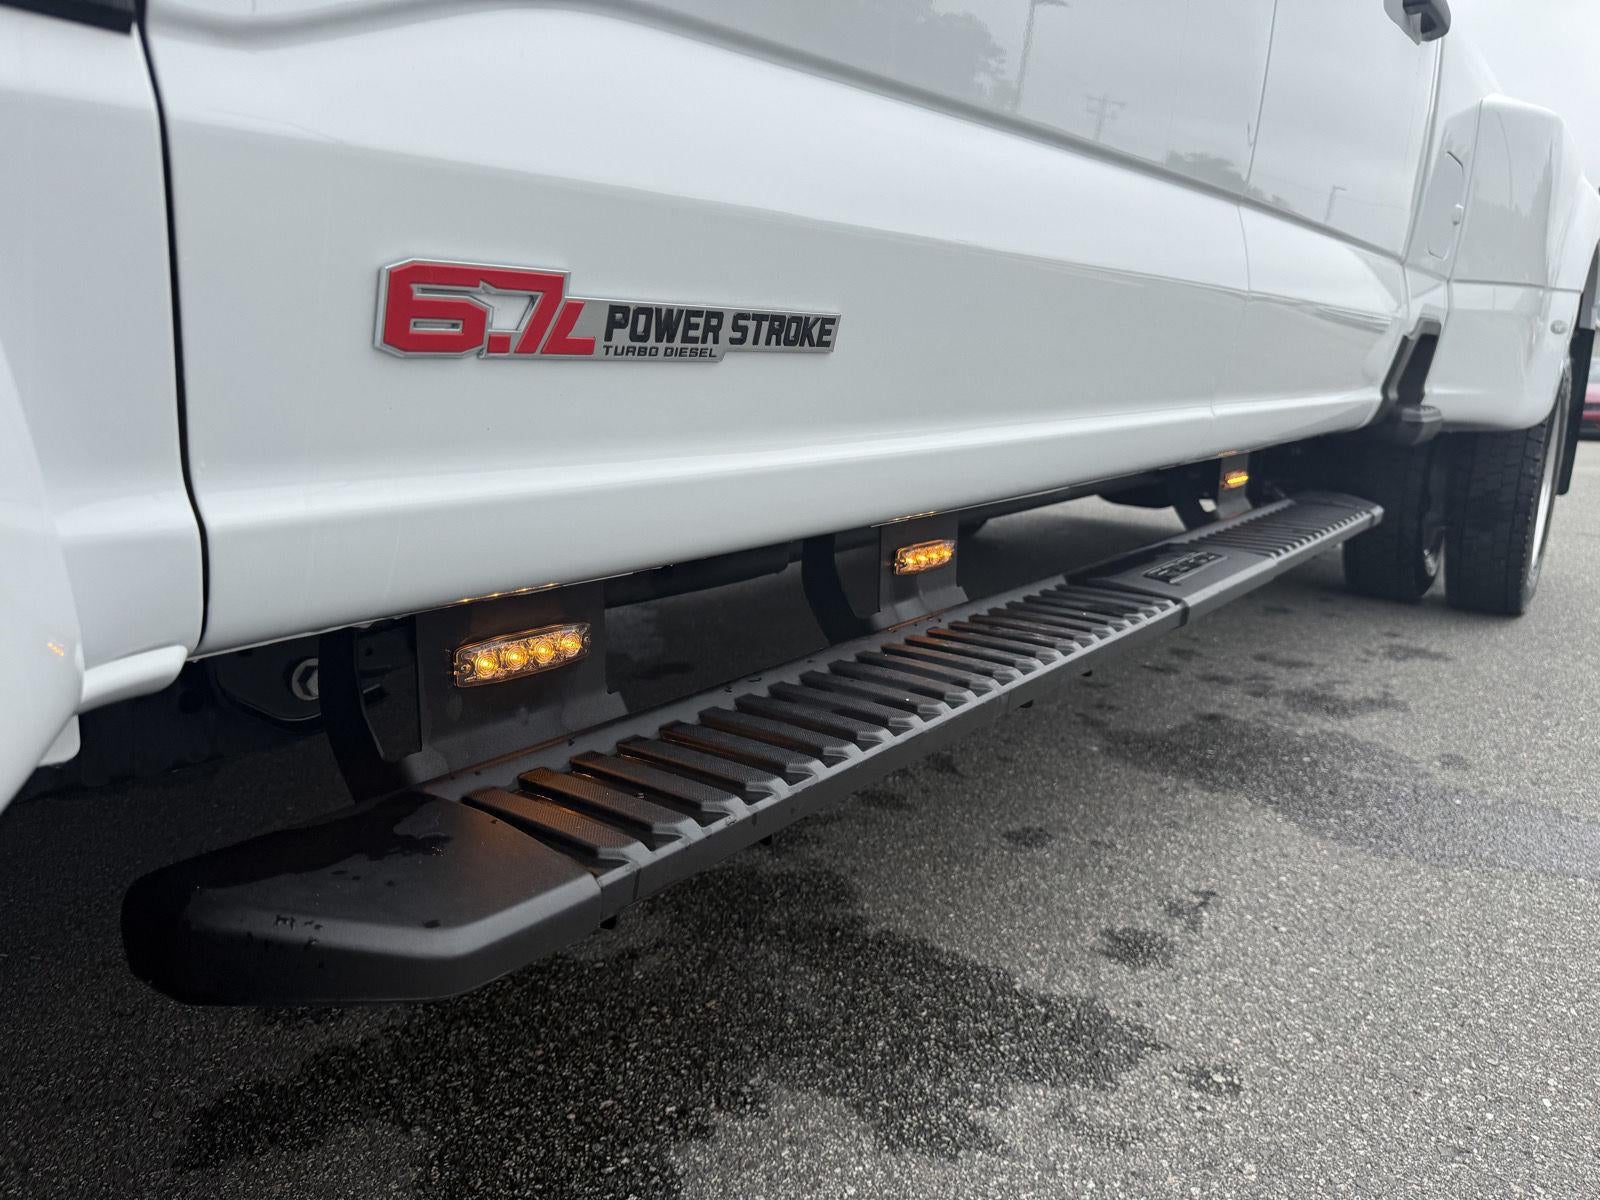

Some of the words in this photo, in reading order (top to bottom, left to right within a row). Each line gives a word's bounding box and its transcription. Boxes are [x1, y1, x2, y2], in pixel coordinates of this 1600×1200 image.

[383, 260, 596, 355] 6.7L
[603, 303, 722, 345] POWER
[728, 312, 837, 348] STROKE
[603, 344, 659, 358] TURBO
[663, 346, 718, 358] DIESEL
